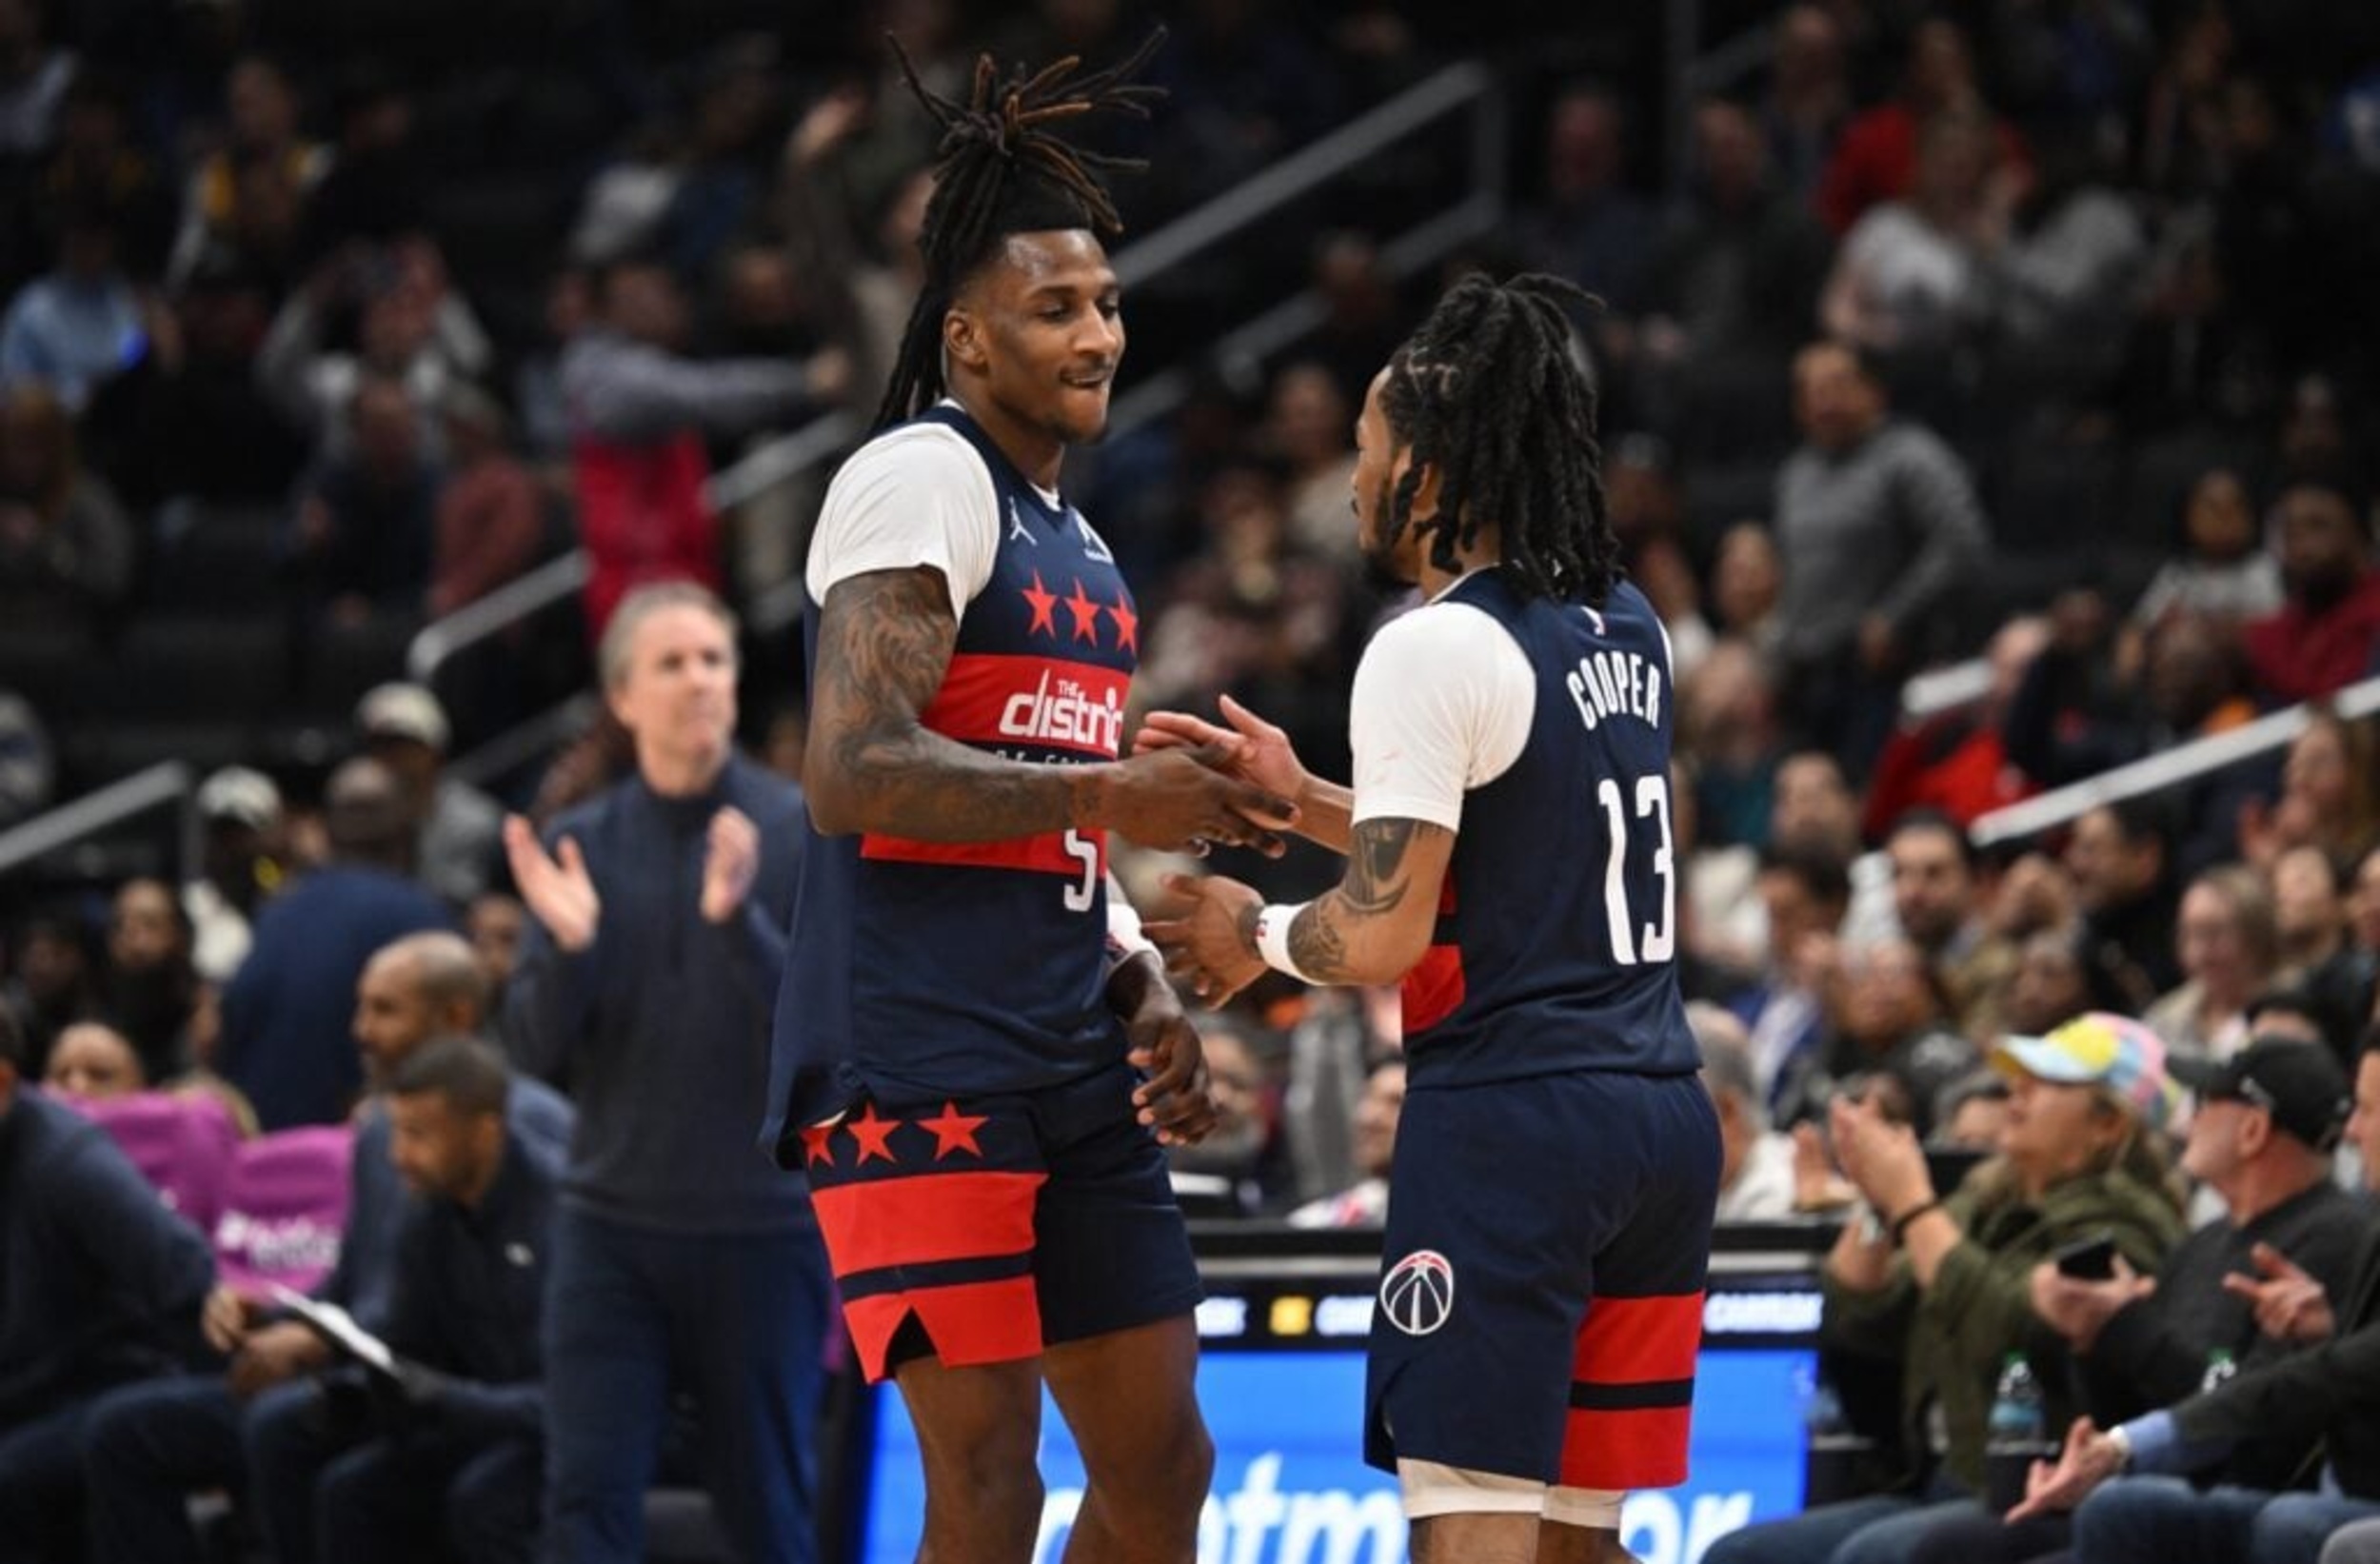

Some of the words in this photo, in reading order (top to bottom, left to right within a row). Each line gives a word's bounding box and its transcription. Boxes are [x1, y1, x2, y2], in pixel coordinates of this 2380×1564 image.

[1057, 679, 1080, 698] THE
[1566, 650, 1661, 730] COOPER
[1064, 828, 1098, 911] 5
[1598, 775, 1676, 965] 13
